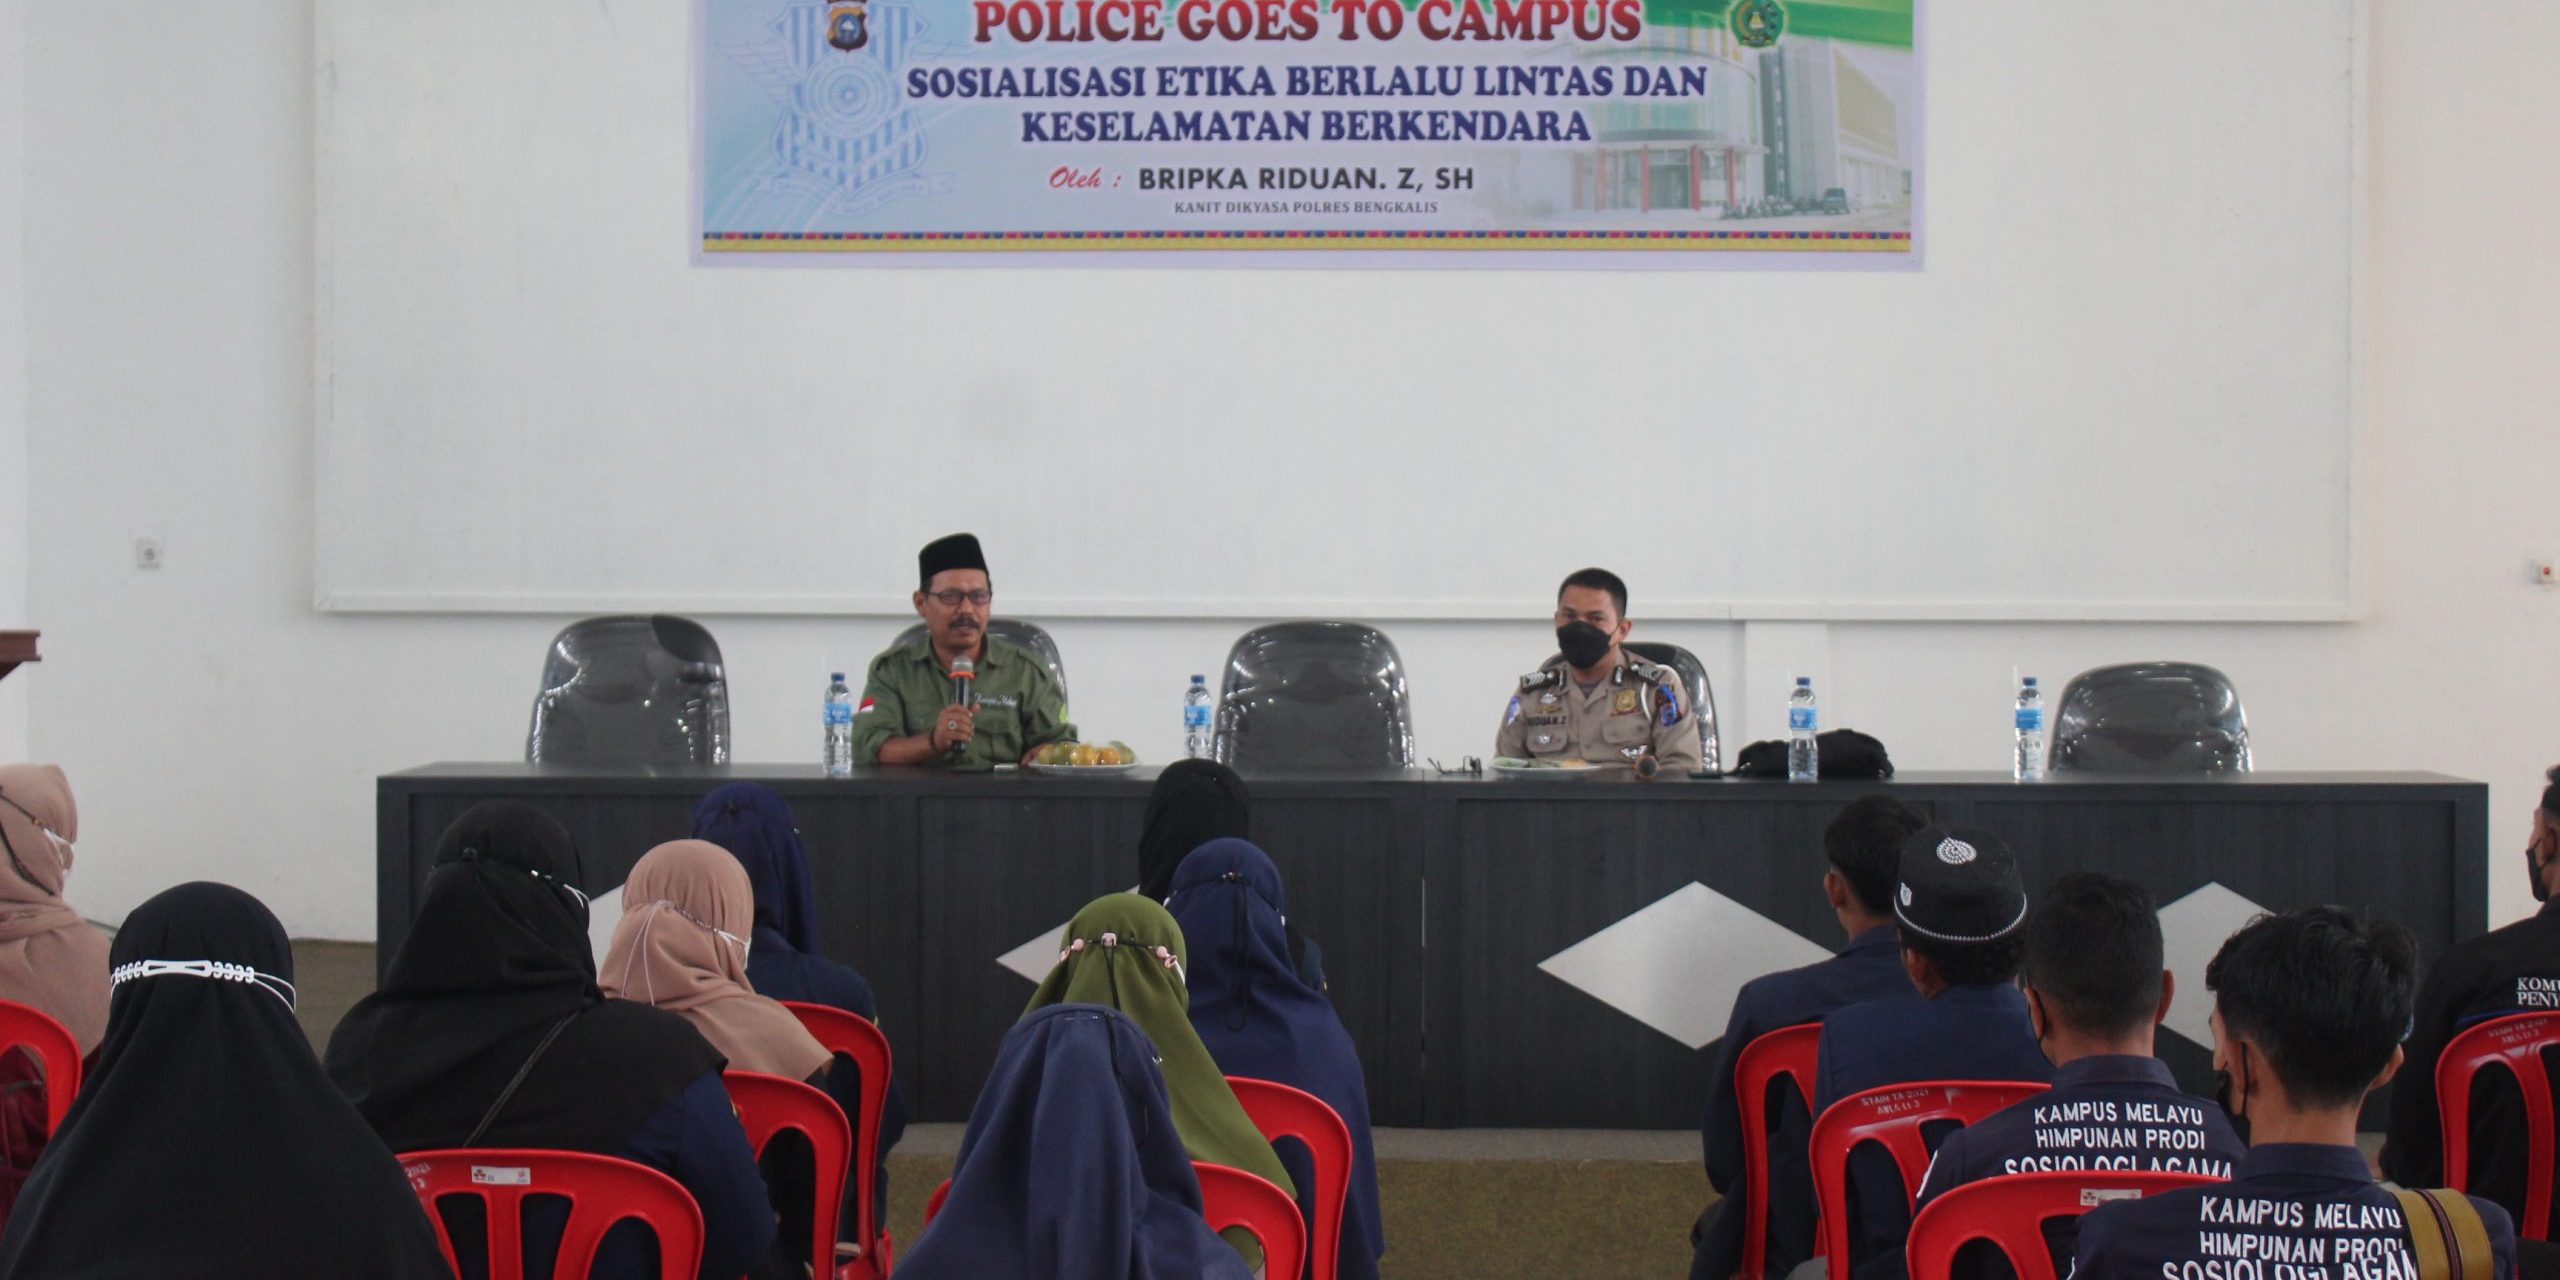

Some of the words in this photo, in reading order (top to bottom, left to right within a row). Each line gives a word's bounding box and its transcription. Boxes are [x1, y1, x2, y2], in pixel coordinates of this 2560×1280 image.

[974, 0, 1164, 42] POLICE
[1177, 0, 1319, 42] GOES
[1332, 0, 1404, 41] TO
[1417, 0, 1641, 41] CAMPUS
[907, 66, 1146, 98] SOSIALISASI
[1156, 66, 1276, 96] ETIKA
[1286, 66, 1464, 96] BERLALU
[1474, 66, 1613, 96] LINTAS
[1623, 66, 1707, 96] DAN
[1021, 111, 1311, 142] KESELAMATAN
[1321, 110, 1591, 141] BERKENDARA
[1050, 166, 1102, 188] Oleh
[1139, 168, 1248, 190] BRIPKA
[1259, 168, 1386, 190] RIDUAN.
[1397, 167, 1423, 193] Z,
[1435, 167, 1473, 190] SH
[1175, 201, 1221, 213] KANIT
[1226, 201, 1289, 213] DIKYASA
[1293, 201, 1350, 213] POLRES
[1354, 201, 1438, 213] BENGKALIS
[2517, 976, 2560, 991] KOM
[2034, 1101, 2118, 1125] KAMPUS
[2125, 1103, 2204, 1125] MELAYU
[2035, 1127, 2137, 1149] HIMPUNAN
[2145, 1129, 2206, 1150] PRODI
[2200, 1196, 2304, 1228] KAMPUS
[2315, 1203, 2402, 1230] MELAYU
[2200, 1231, 2325, 1263] HIMPUNAN
